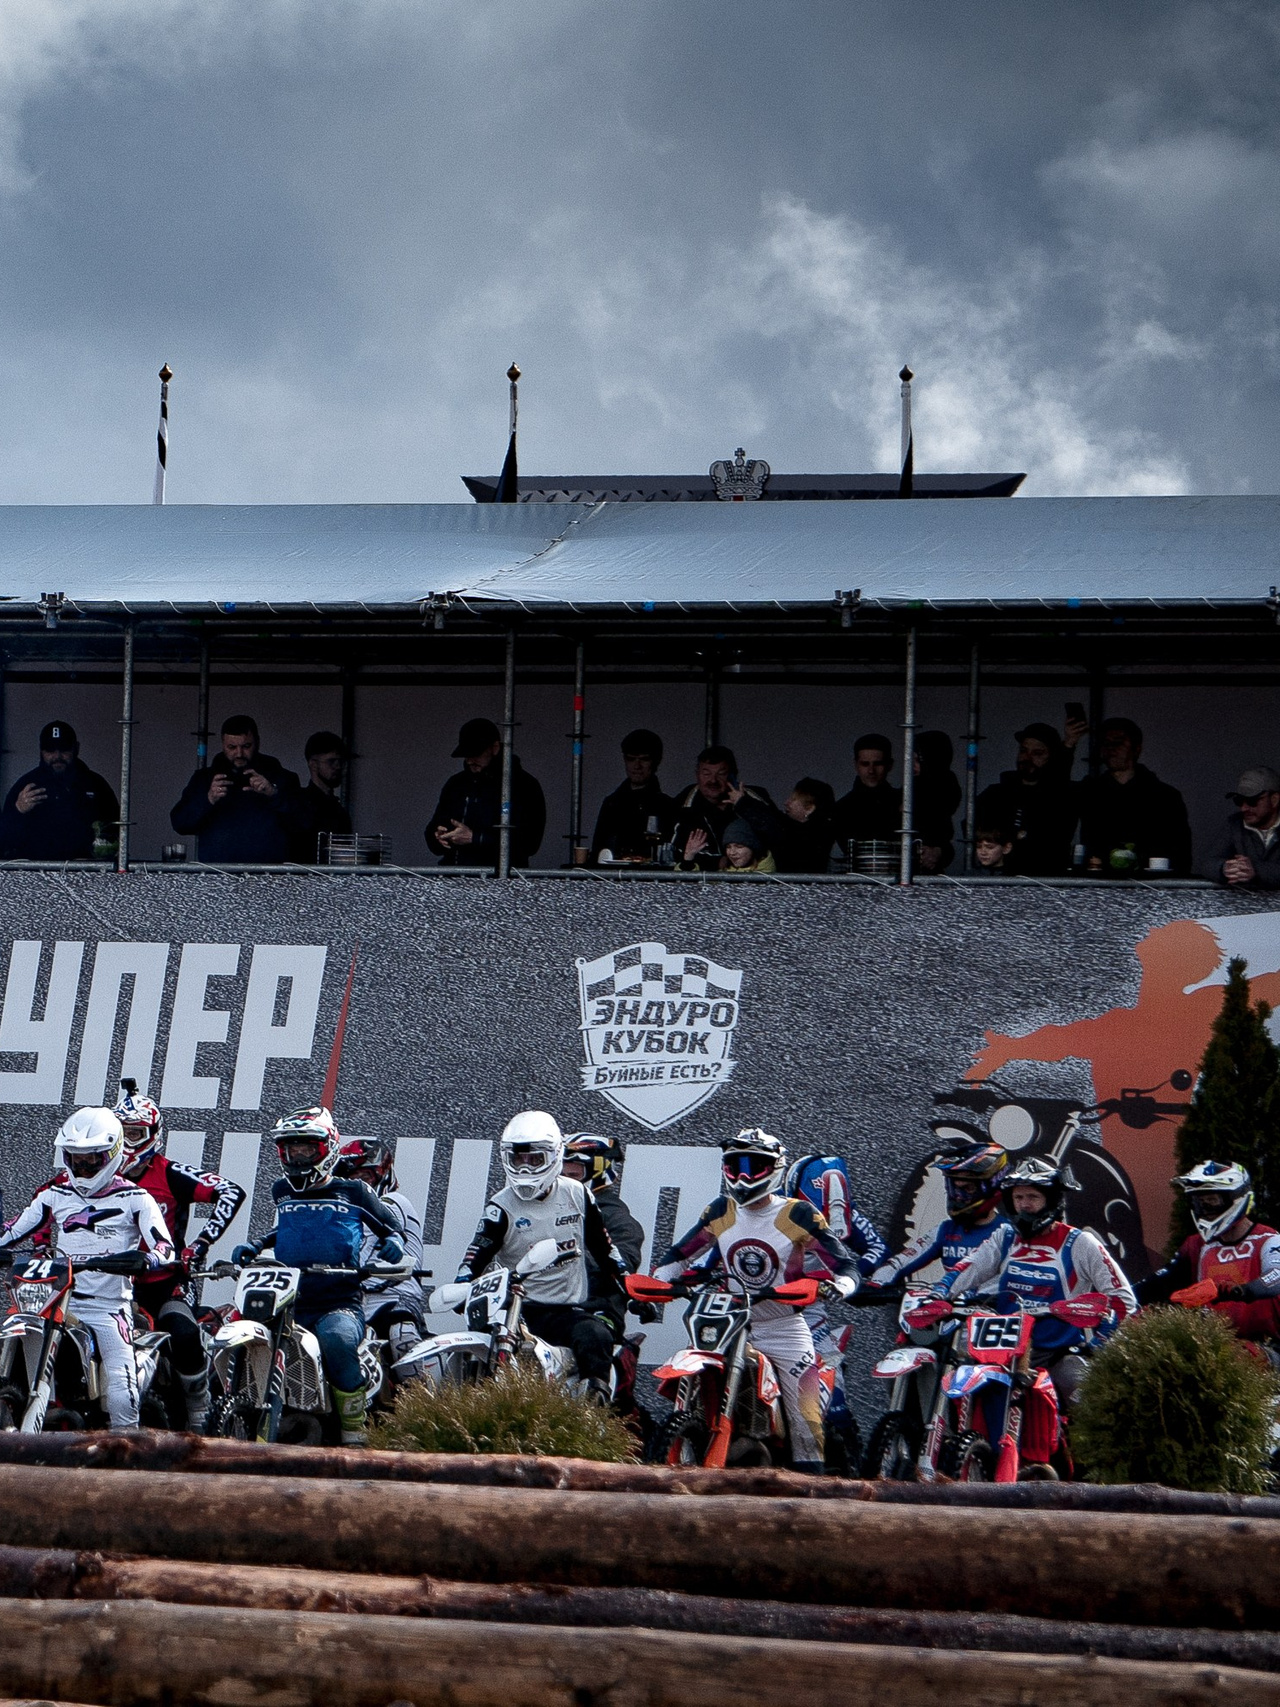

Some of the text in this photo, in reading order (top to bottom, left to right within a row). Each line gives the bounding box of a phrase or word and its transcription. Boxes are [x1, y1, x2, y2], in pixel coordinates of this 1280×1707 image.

[590, 1000, 735, 1028] ЭНДУРО
[601, 1030, 711, 1055] КУБОК
[23, 1259, 52, 1278] 24
[243, 1271, 293, 1290] 225
[693, 1293, 733, 1314] 119
[972, 1316, 1021, 1350] 165
[789, 1350, 814, 1379] RACE
